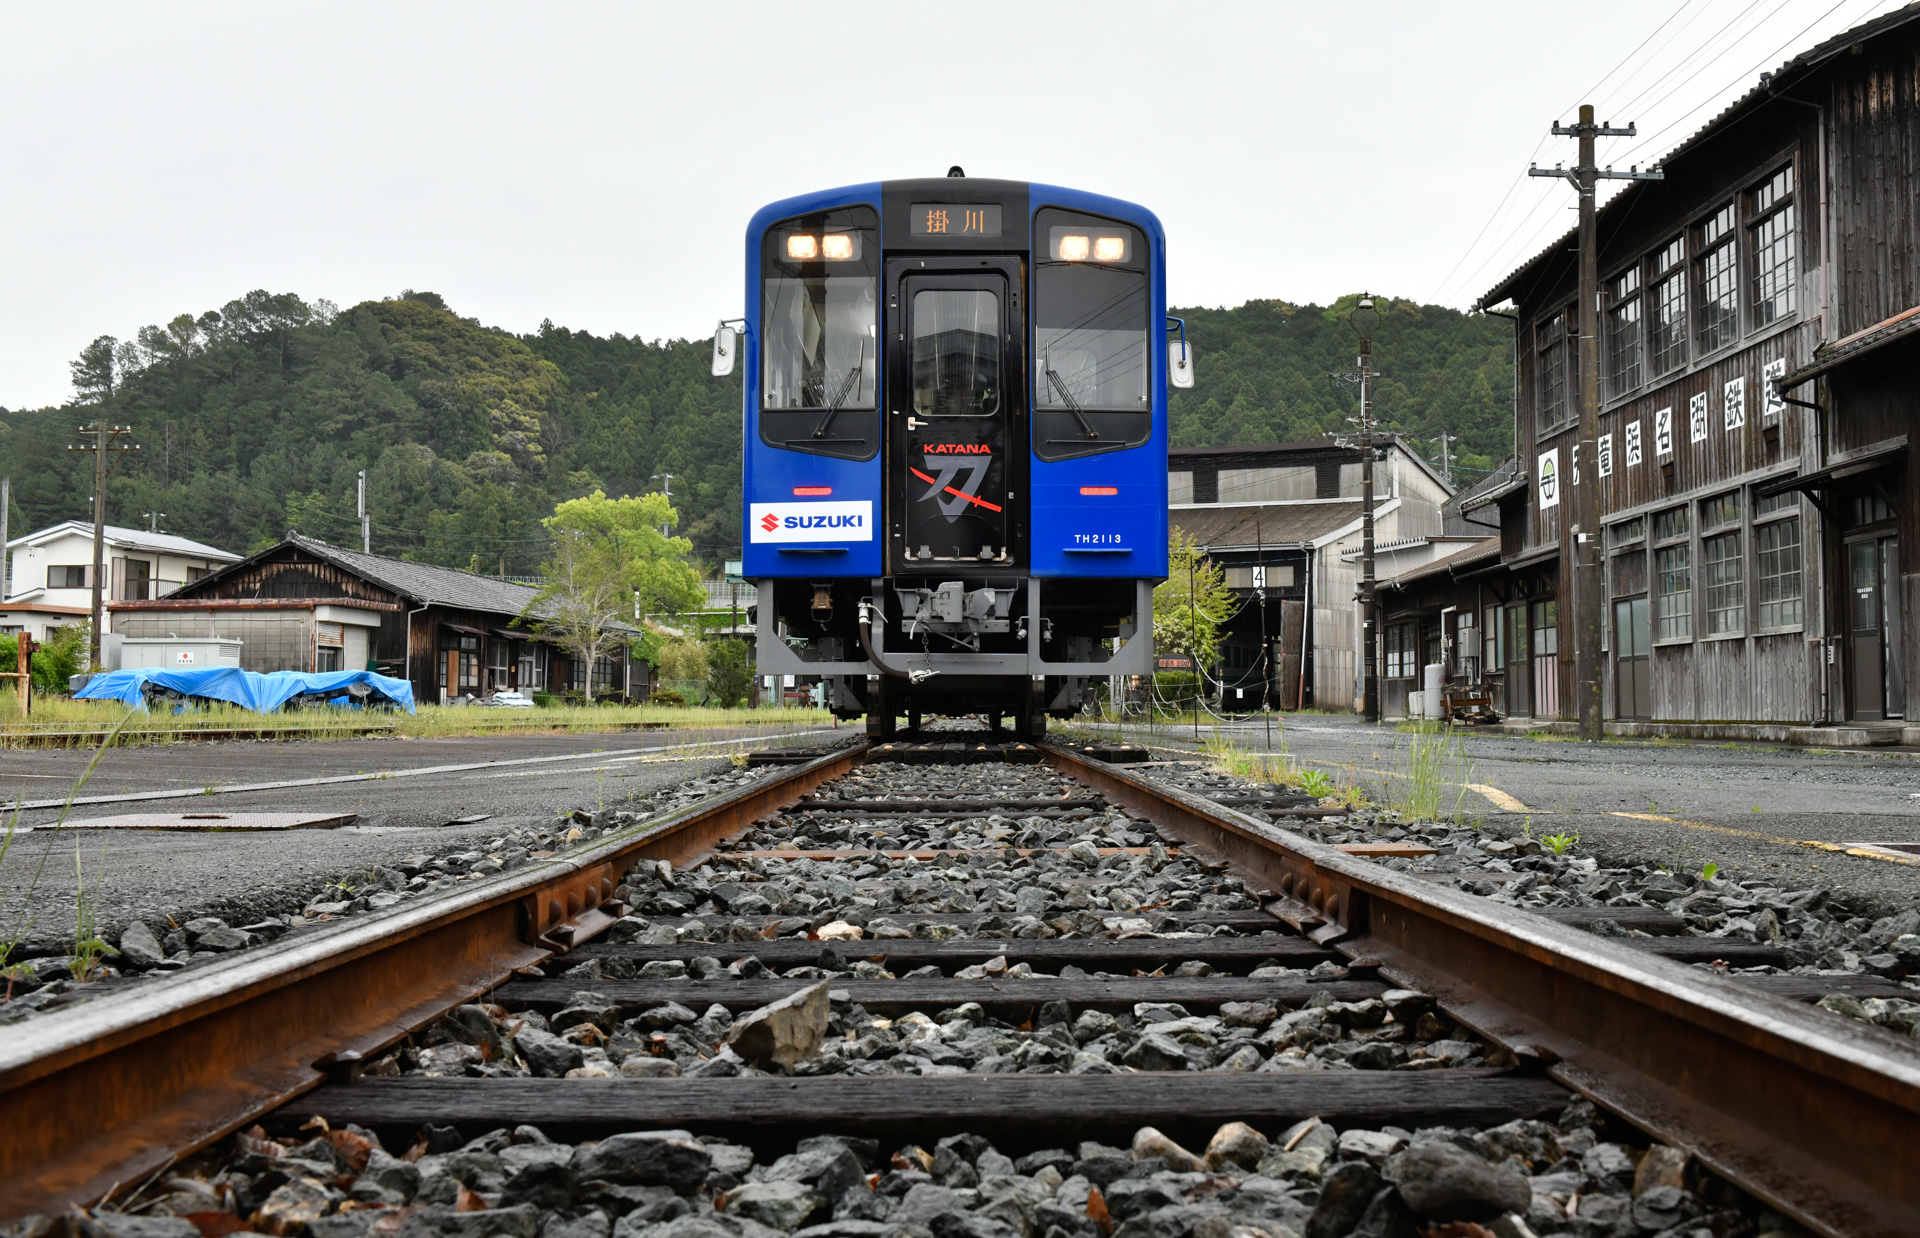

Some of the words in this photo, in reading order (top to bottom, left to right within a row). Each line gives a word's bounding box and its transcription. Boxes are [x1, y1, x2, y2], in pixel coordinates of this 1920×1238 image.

[926, 210, 984, 233] 掛川
[923, 443, 992, 454] KATANA
[784, 515, 863, 529] SUZUKI
[1074, 534, 1121, 544] TH2113
